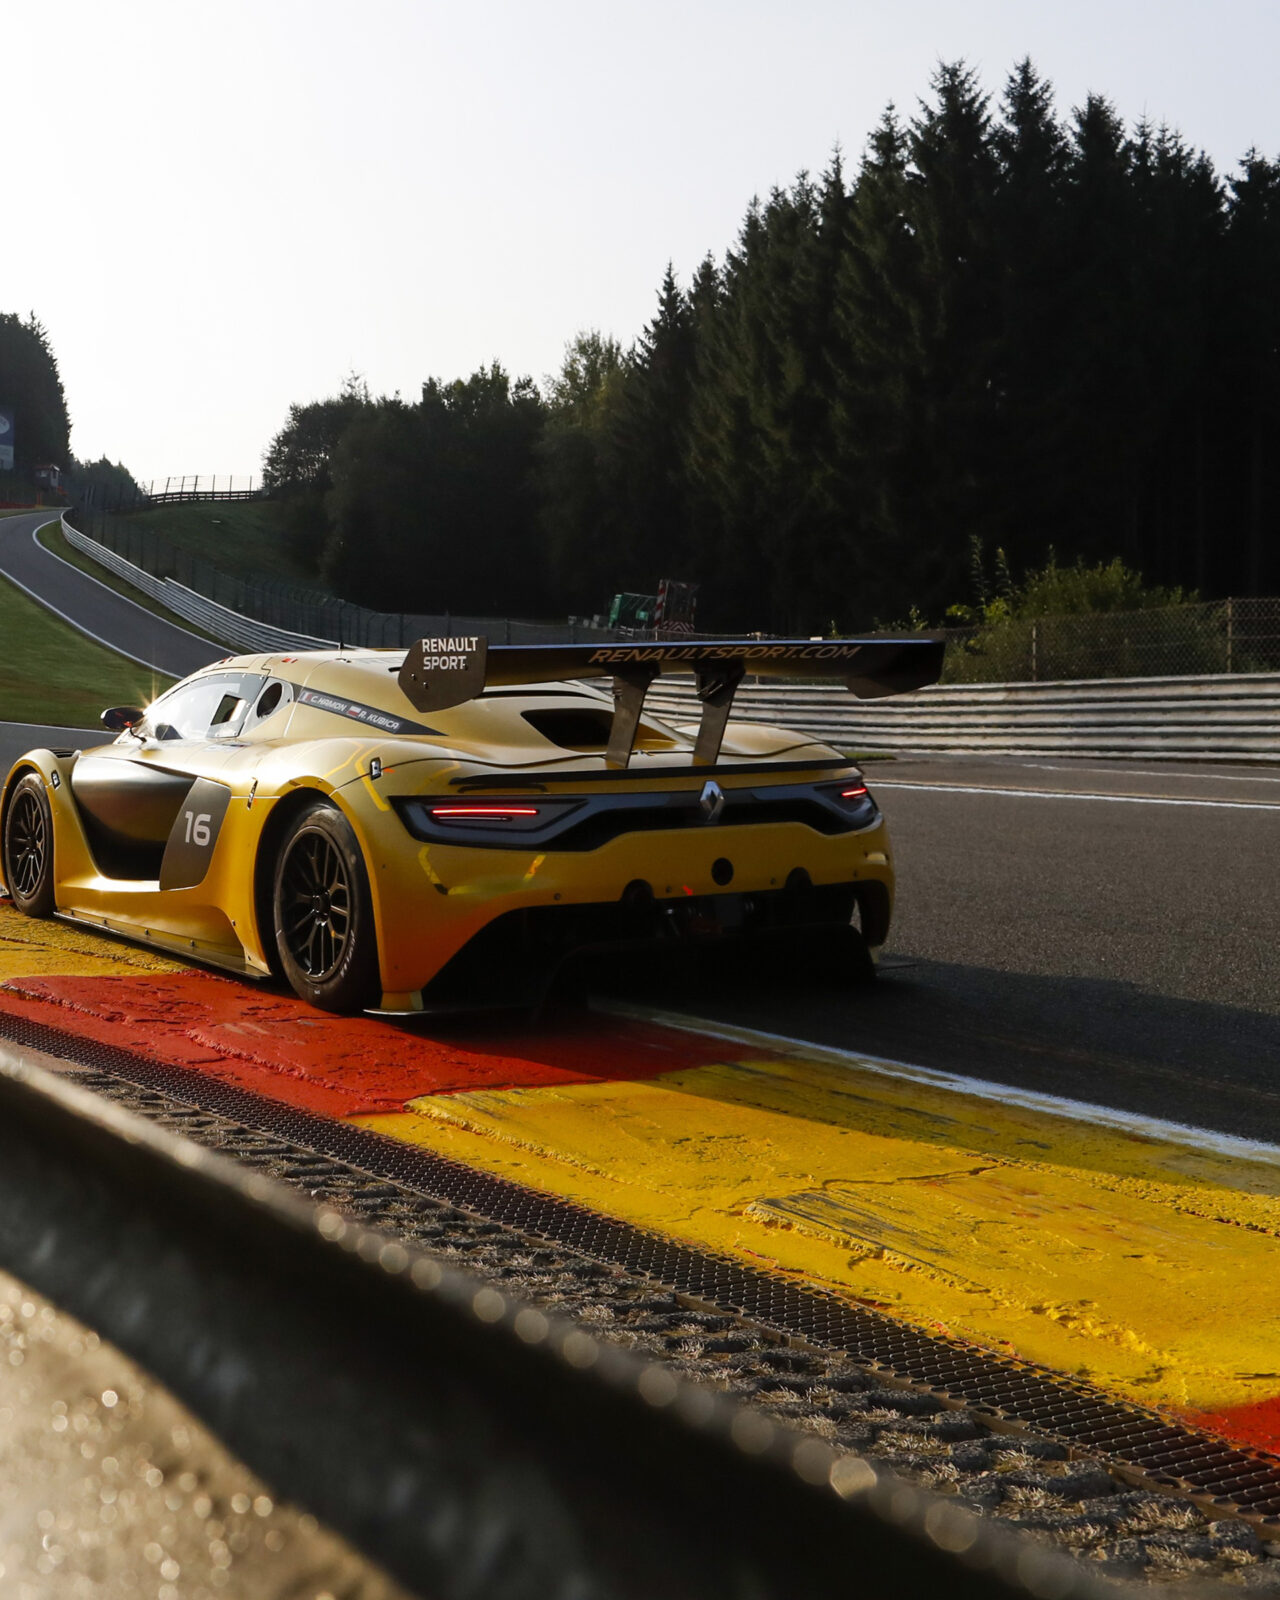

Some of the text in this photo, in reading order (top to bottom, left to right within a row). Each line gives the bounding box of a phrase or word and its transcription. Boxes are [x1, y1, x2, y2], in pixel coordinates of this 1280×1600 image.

[422, 637, 478, 653] RENAULT
[588, 645, 862, 663] RENAULTSPORT.COM
[423, 655, 467, 670] SPORT
[358, 710, 367, 719] R.
[366, 713, 400, 729] KUBICA
[185, 811, 211, 846] 16
